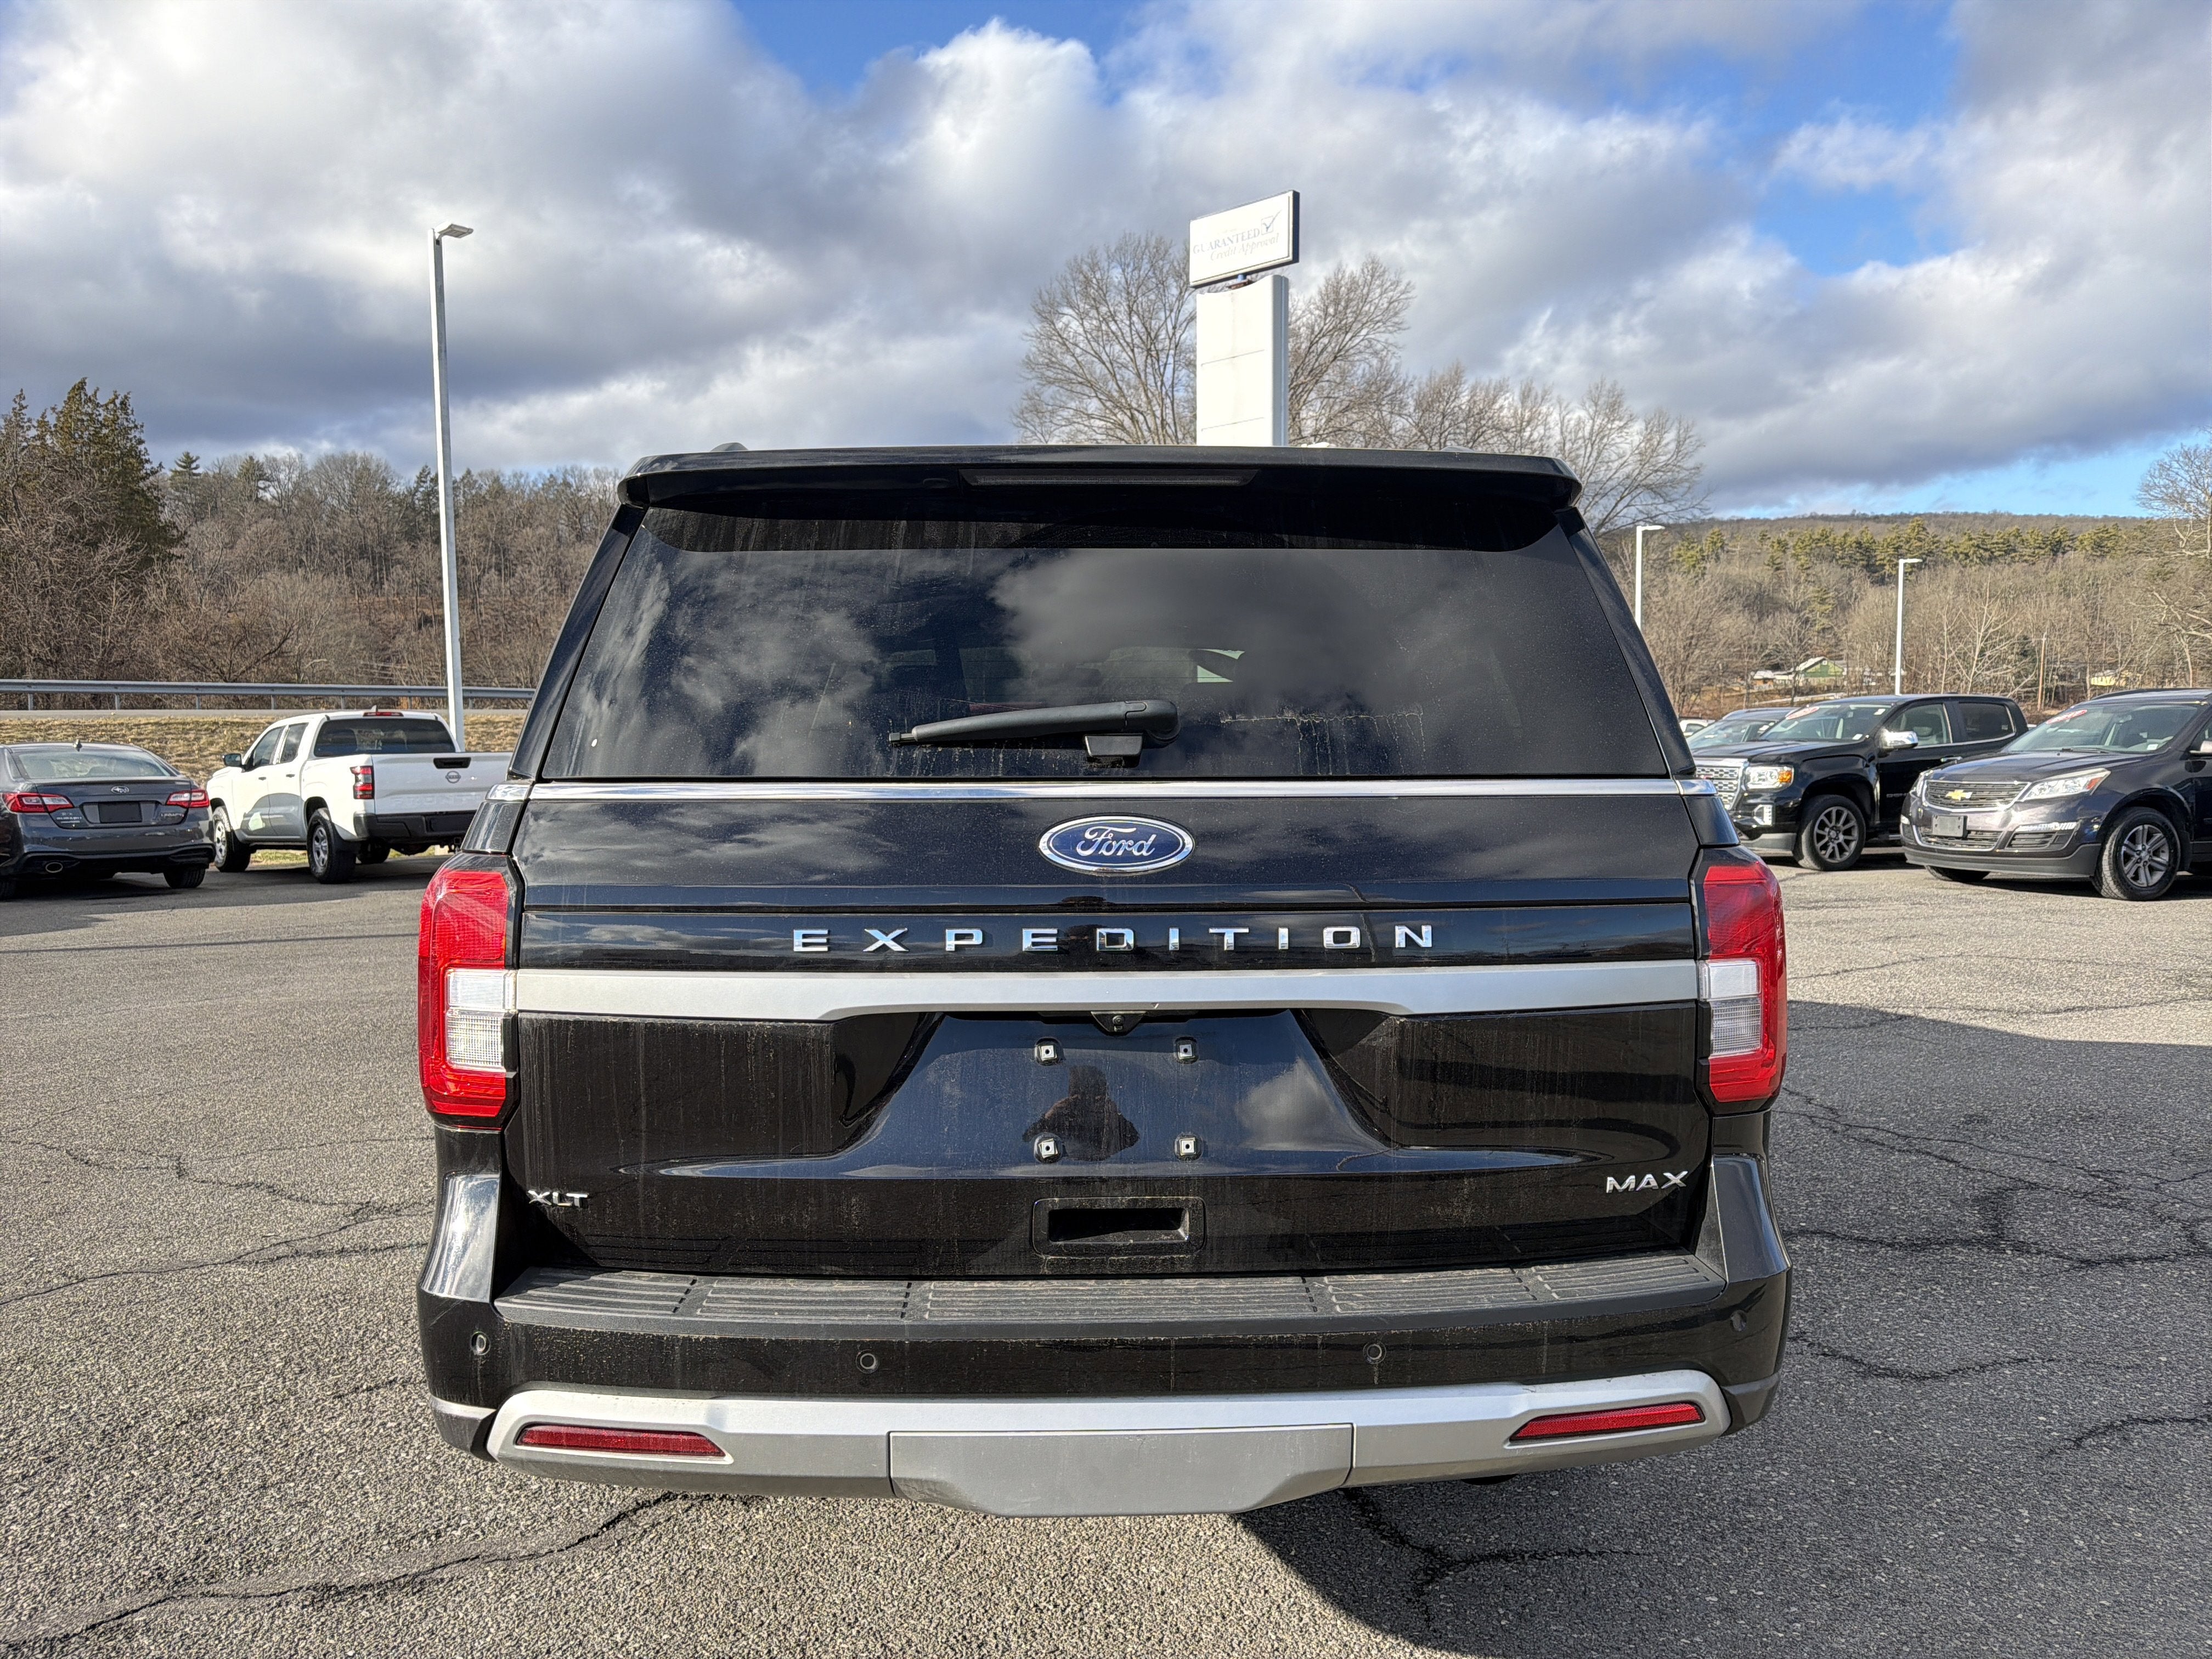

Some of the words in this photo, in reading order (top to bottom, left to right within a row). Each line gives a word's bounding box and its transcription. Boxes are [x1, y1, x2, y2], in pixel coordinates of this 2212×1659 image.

[1193, 228, 1260, 254] GUARANTEED
[1210, 246, 1237, 261] Credit
[1239, 233, 1279, 255] Approval
[1076, 826, 1156, 856] Ford
[793, 925, 1433, 952] EXPEDITION
[1606, 1171, 1688, 1193] MAX
[528, 1190, 589, 1208] XLT
